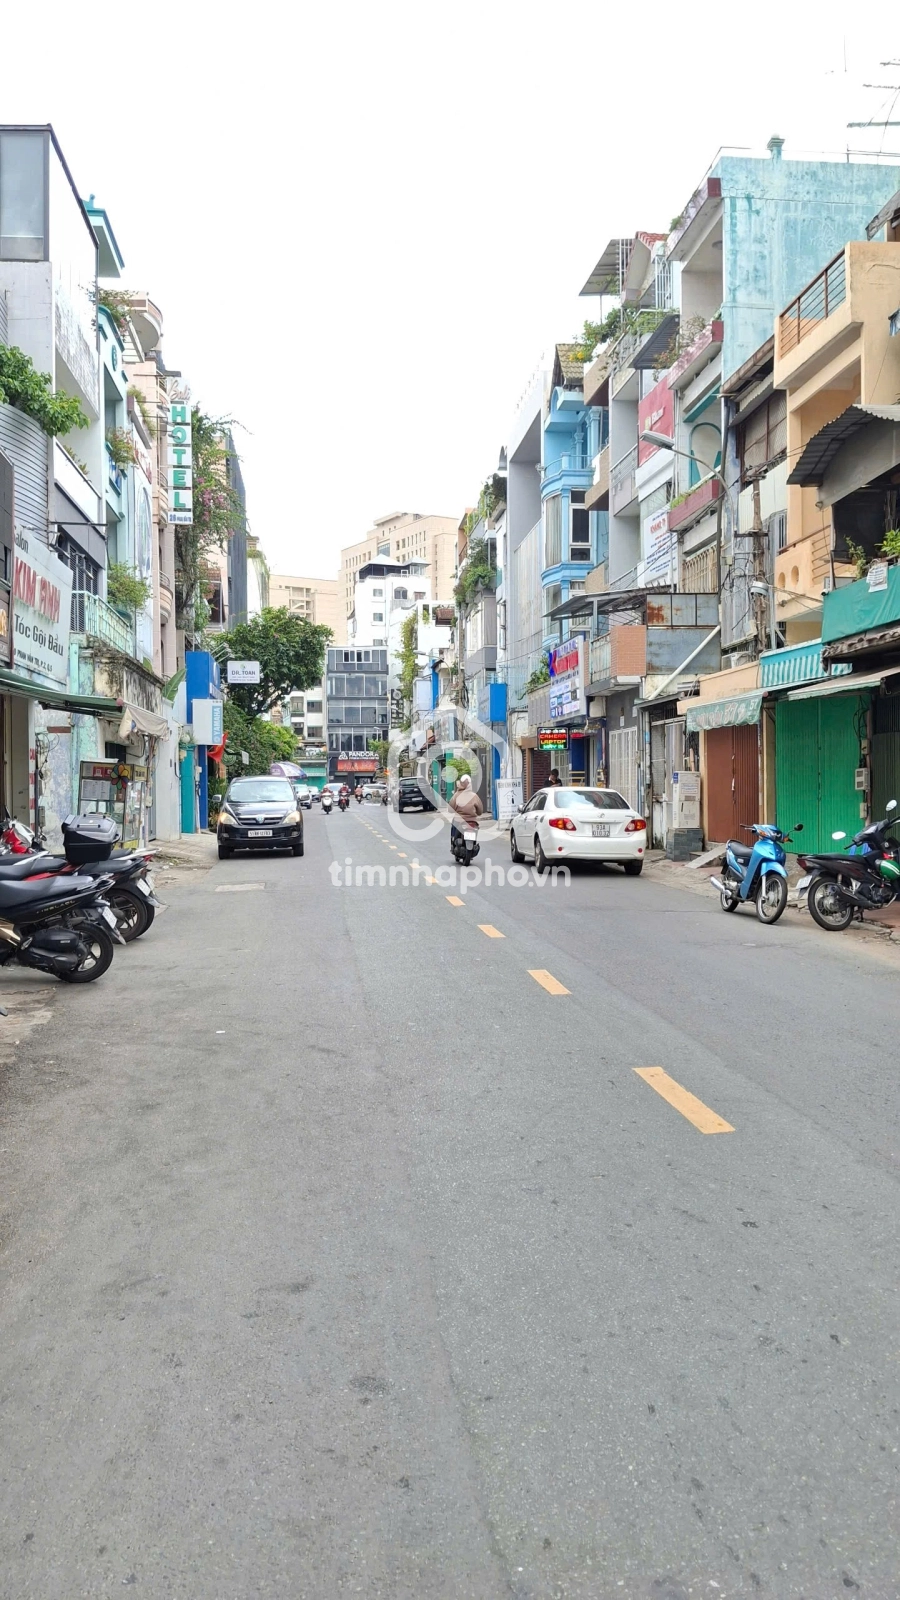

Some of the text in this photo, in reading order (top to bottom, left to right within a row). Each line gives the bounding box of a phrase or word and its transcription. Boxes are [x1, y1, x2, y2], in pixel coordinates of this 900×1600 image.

[171, 405, 188, 509] HOTEL
[13, 525, 29, 554] alon
[13, 555, 37, 609] KIM
[14, 613, 31, 638] Tóc
[33, 625, 47, 648] Gội
[213, 707, 221, 736] YAMAHA
